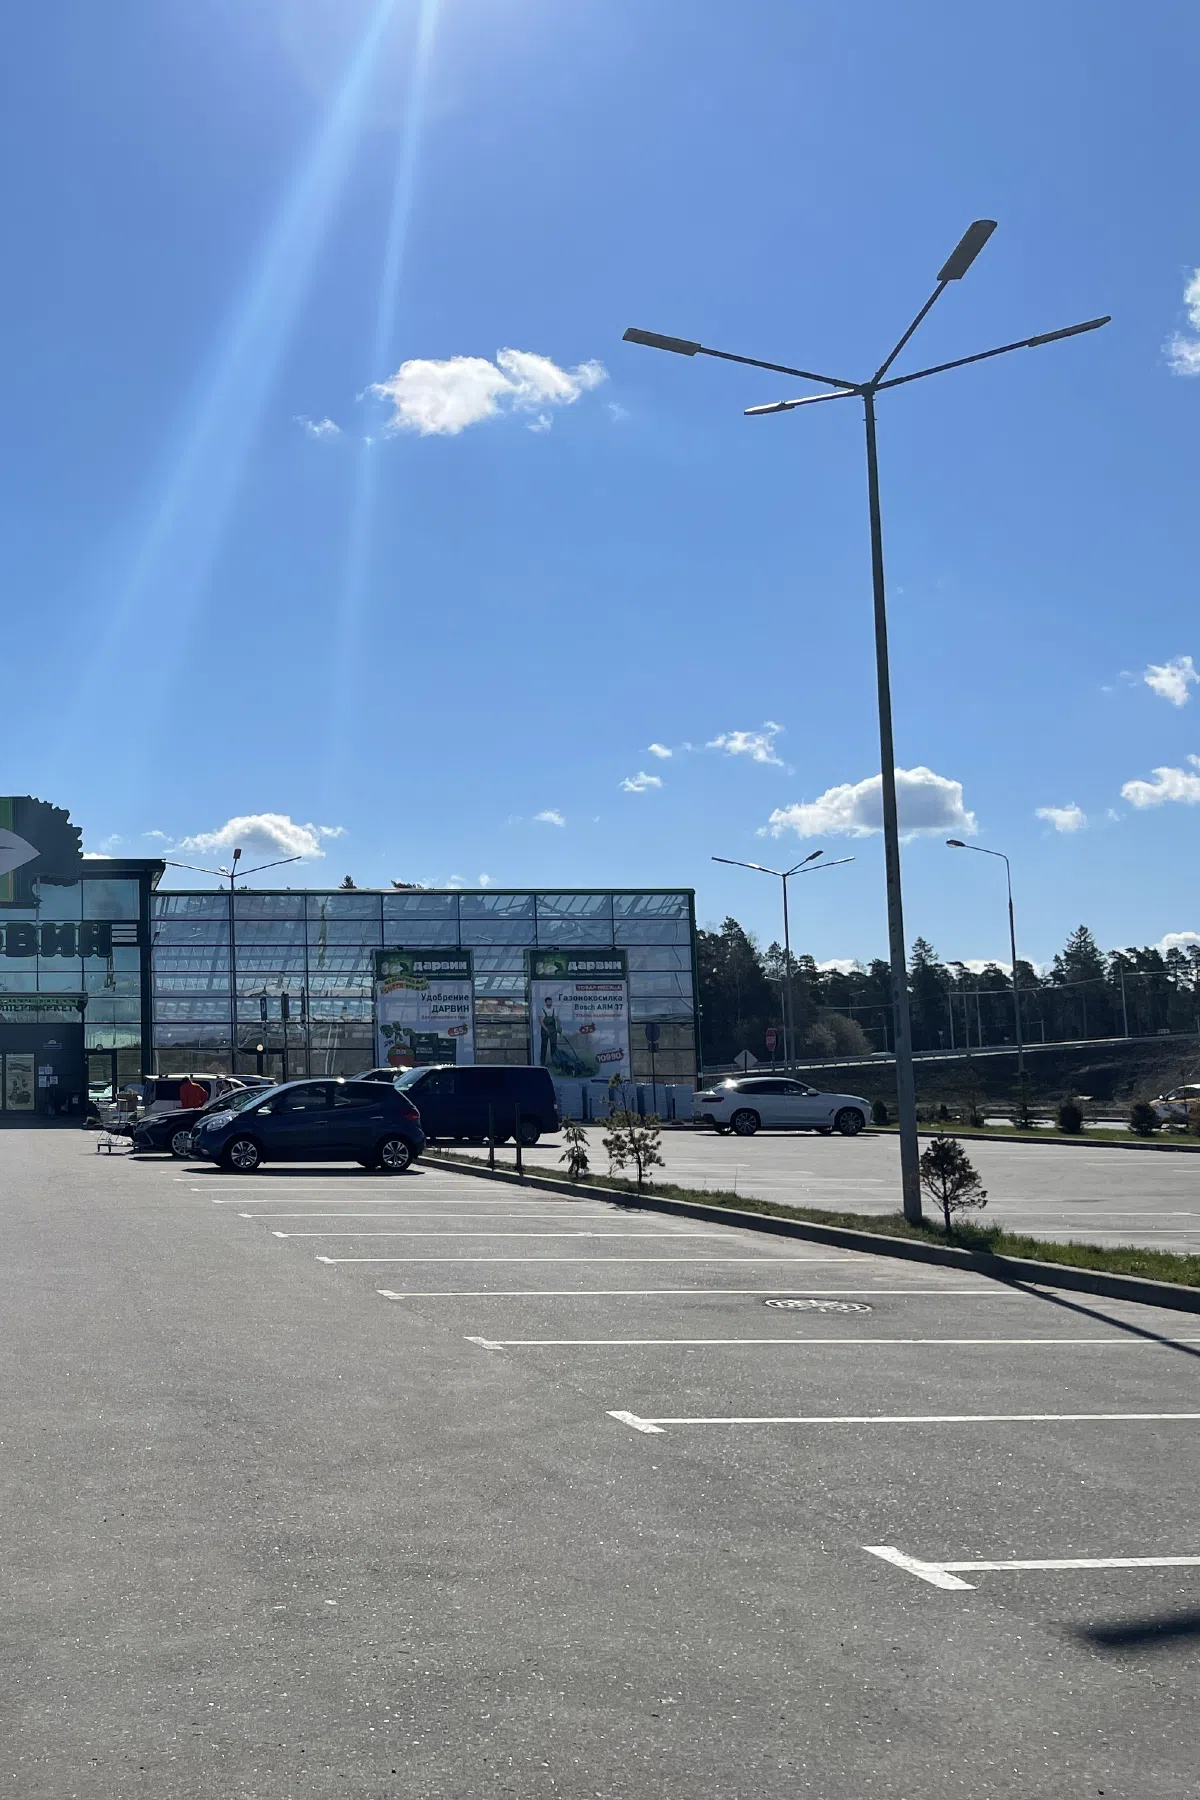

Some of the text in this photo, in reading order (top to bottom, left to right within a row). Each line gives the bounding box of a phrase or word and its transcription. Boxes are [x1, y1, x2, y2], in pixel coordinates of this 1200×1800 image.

[421, 993, 470, 1002] Удобрение
[431, 1004, 470, 1014] ДАРВИН
[574, 1003, 623, 1011] Bosch ARM 37
